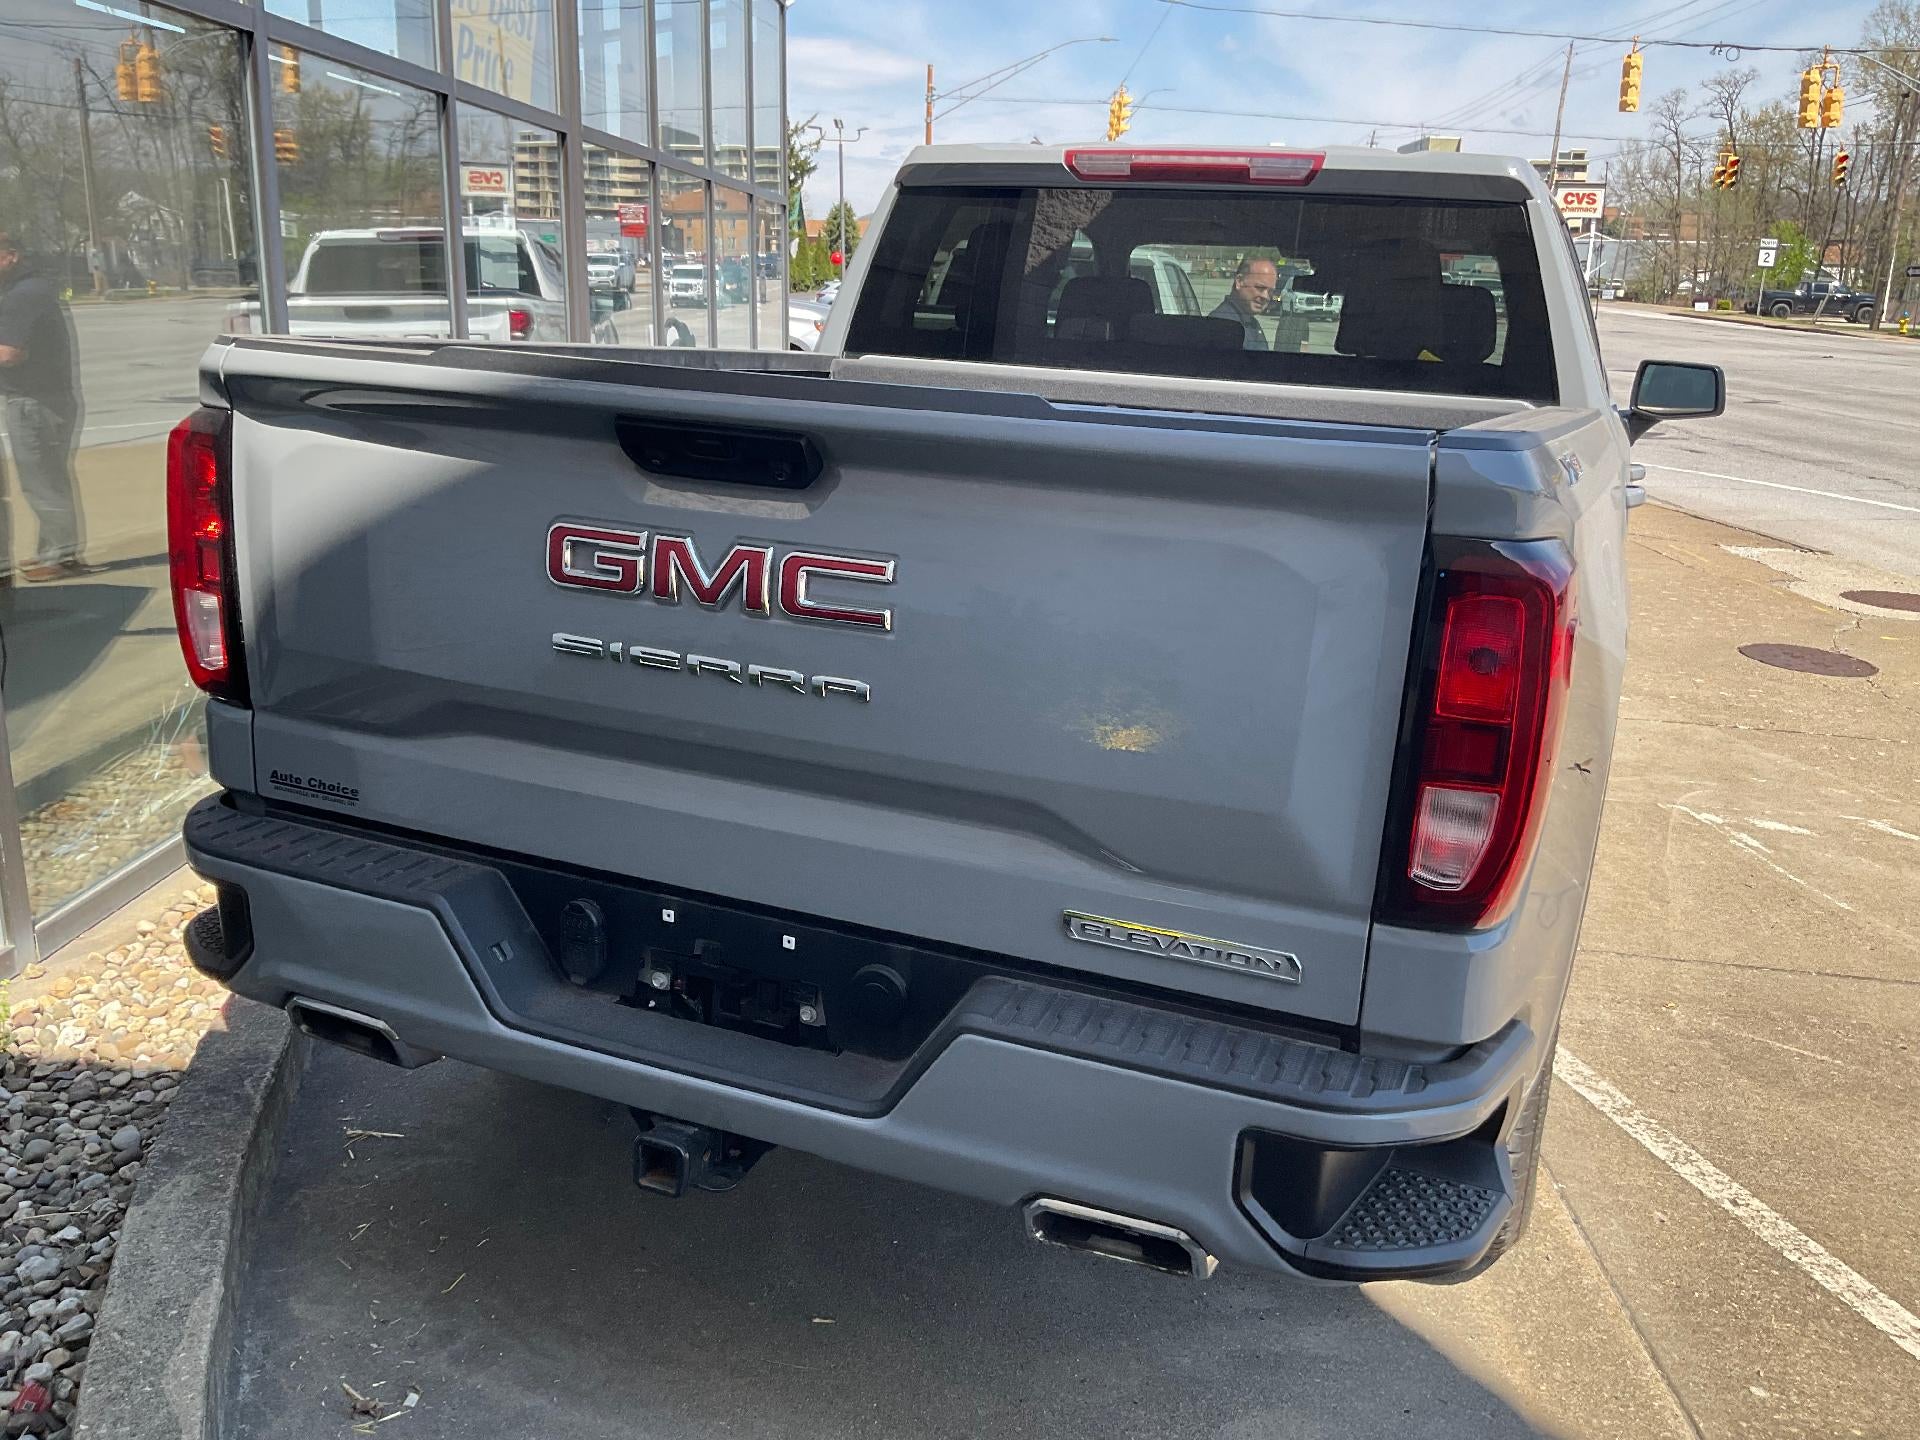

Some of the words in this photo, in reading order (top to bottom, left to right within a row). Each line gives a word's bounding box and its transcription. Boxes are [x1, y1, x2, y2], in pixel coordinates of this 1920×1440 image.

[455, 22, 514, 92] Price
[1563, 191, 1597, 205] CVS
[1763, 252, 1771, 263] 2
[546, 522, 895, 631] GMC
[552, 632, 871, 702] SIERRA
[269, 769, 302, 785] Auto
[308, 777, 360, 797] Choice
[1080, 921, 1282, 972] ELEVATION
